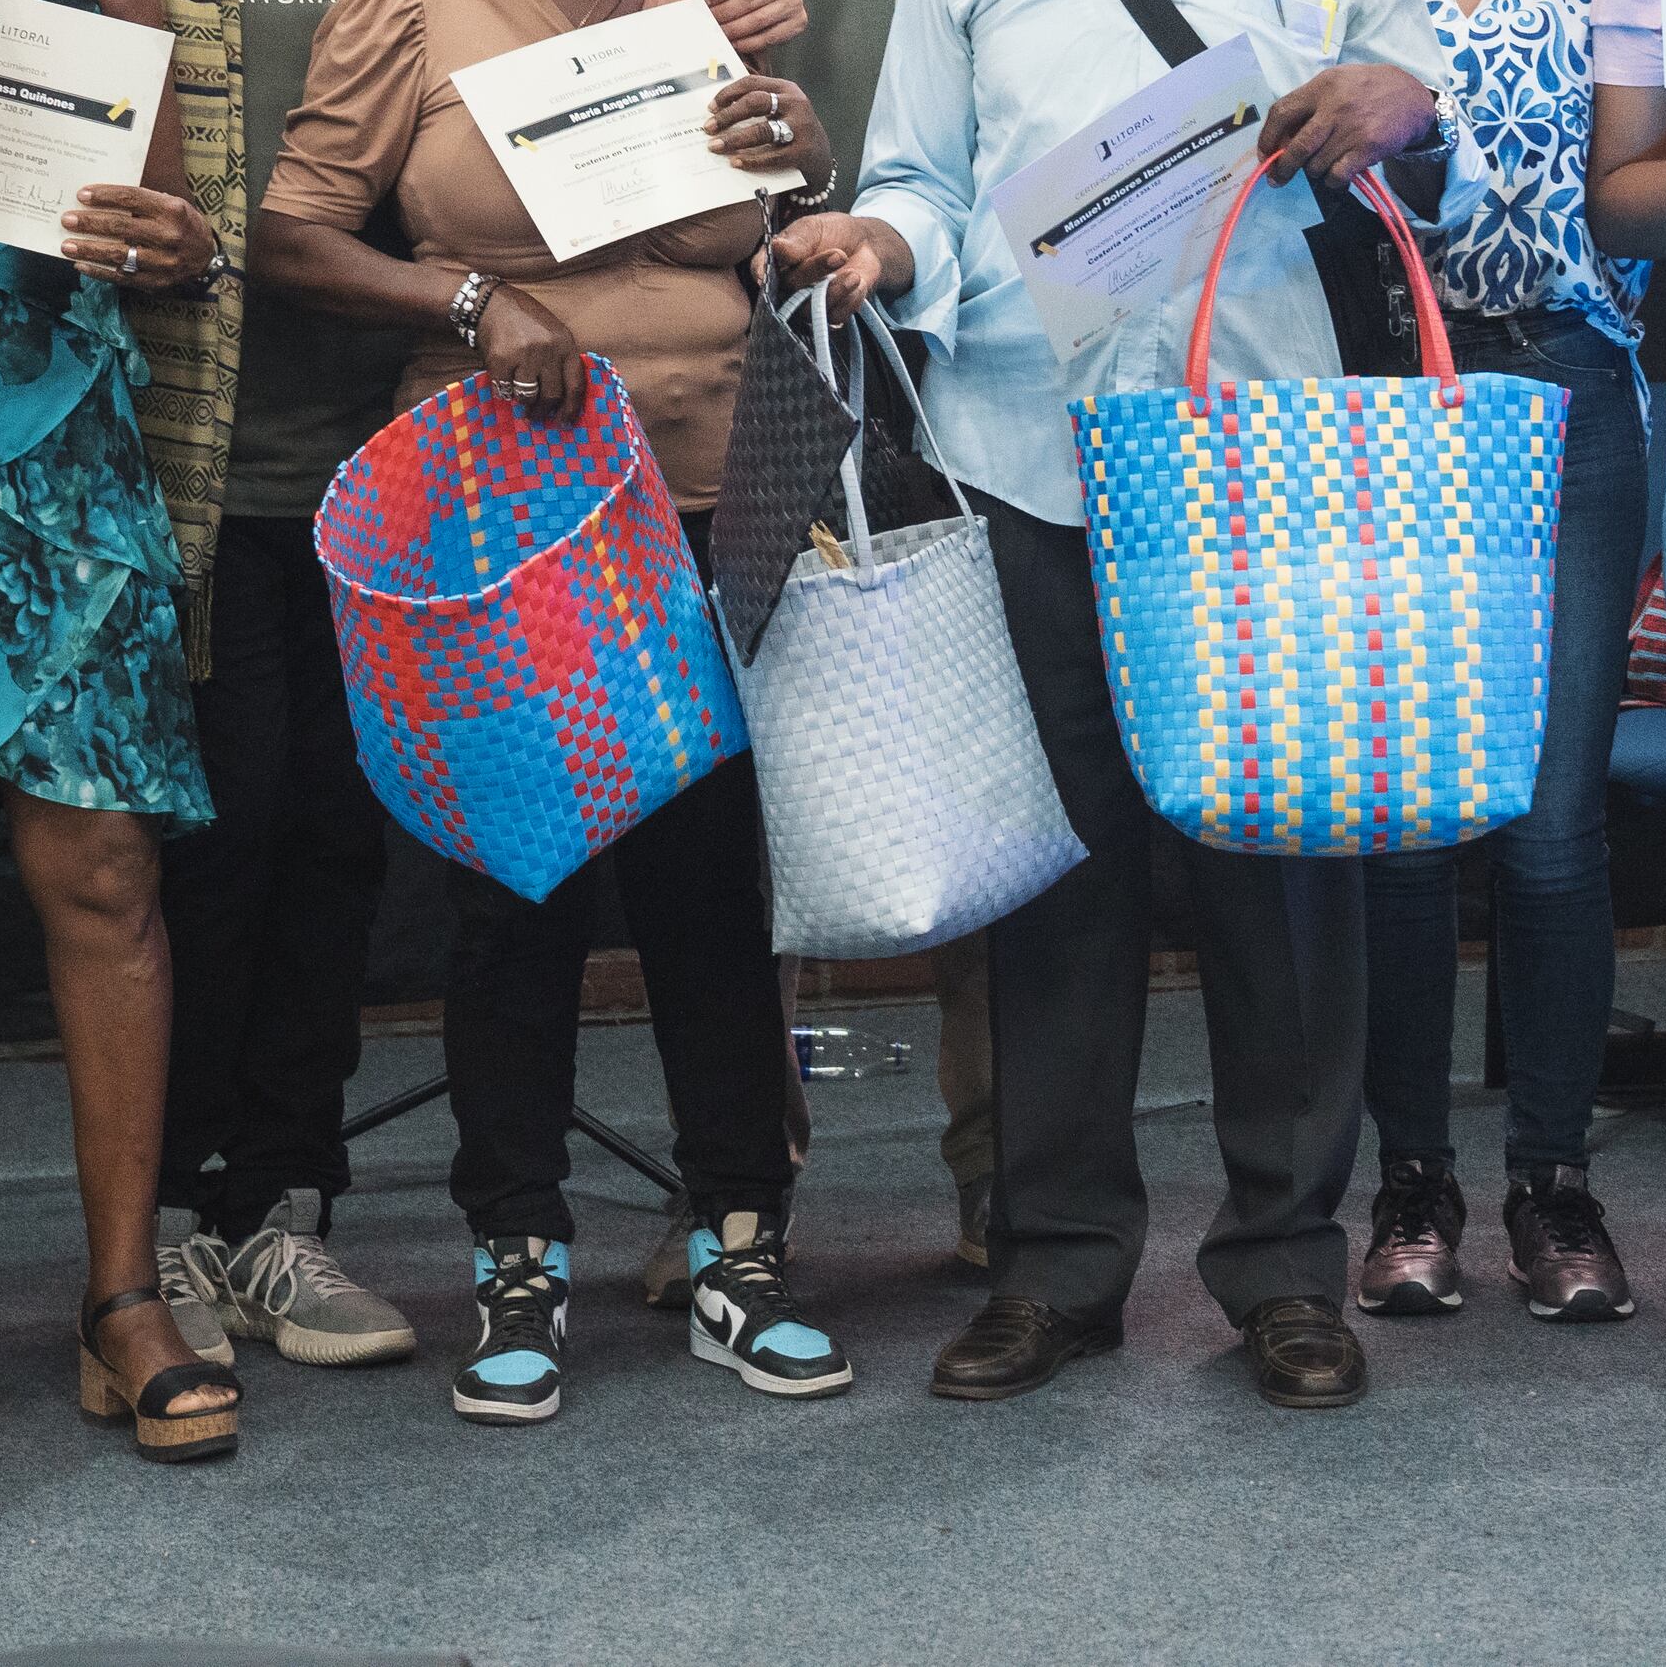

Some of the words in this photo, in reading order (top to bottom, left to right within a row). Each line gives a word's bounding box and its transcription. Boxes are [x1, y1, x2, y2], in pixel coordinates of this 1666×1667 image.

[1, 24, 51, 46] LITORAL
[582, 44, 625, 64] LITORAL
[18, 87, 76, 112] Quiñones
[601, 92, 639, 113] Angela
[638, 82, 675, 100] Murillo
[1109, 113, 1155, 146] LITORAL
[13, 151, 24, 159] en
[24, 154, 48, 167] sarga
[1062, 201, 1102, 234] Manuel
[1101, 174, 1143, 207] Dolores
[1142, 144, 1191, 181] Ibarguen
[1189, 125, 1226, 150] López
[1073, 162, 1125, 199] CERTIFICADO
[1121, 231, 1134, 242] en
[1133, 212, 1162, 233] Trenza
[1169, 192, 1194, 212] tejido
[1194, 185, 1207, 196] en
[1206, 171, 1233, 190] sarga
